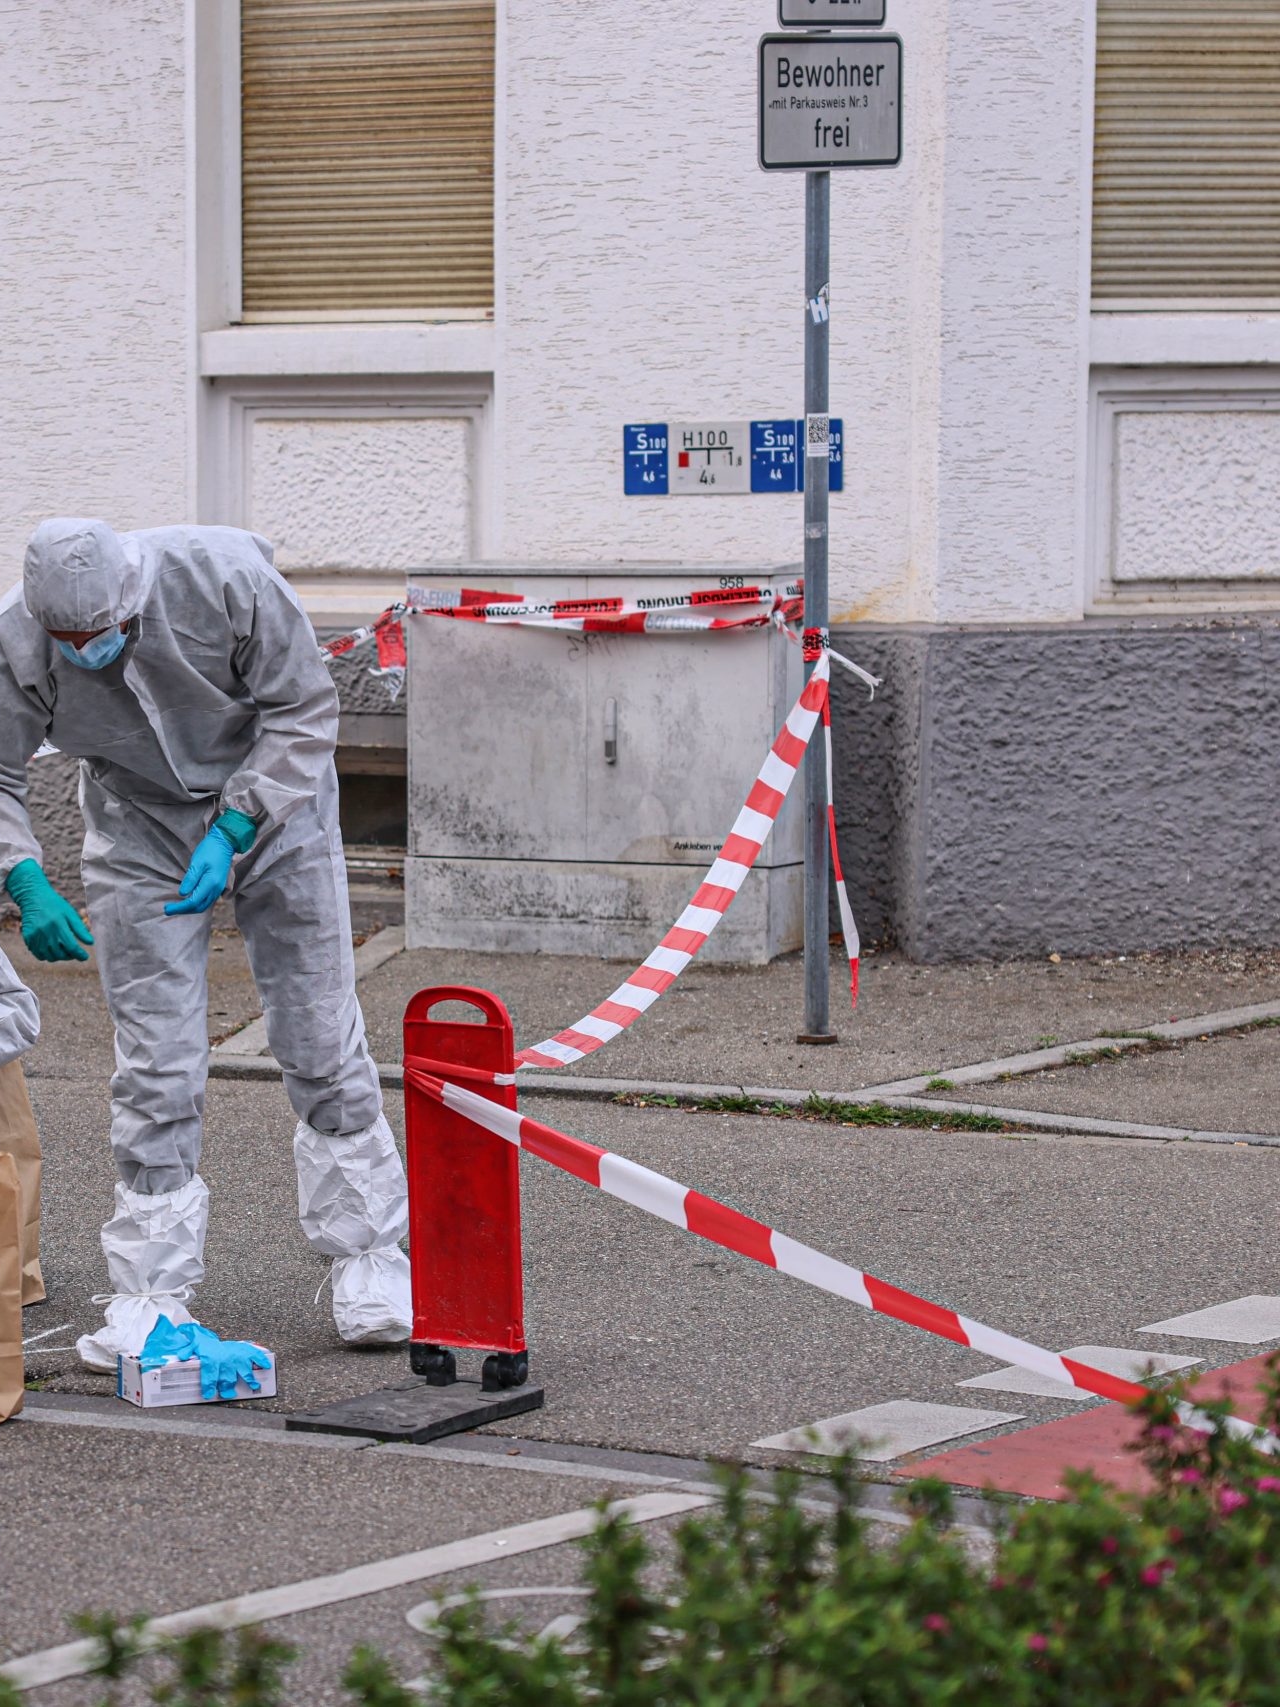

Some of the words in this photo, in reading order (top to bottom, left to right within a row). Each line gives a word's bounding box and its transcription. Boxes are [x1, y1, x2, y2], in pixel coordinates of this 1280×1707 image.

[777, 56, 885, 88] Bewohner
[772, 97, 787, 109] mit
[790, 96, 846, 110] Parkausweis
[815, 117, 850, 148] frei
[719, 576, 744, 589] 958
